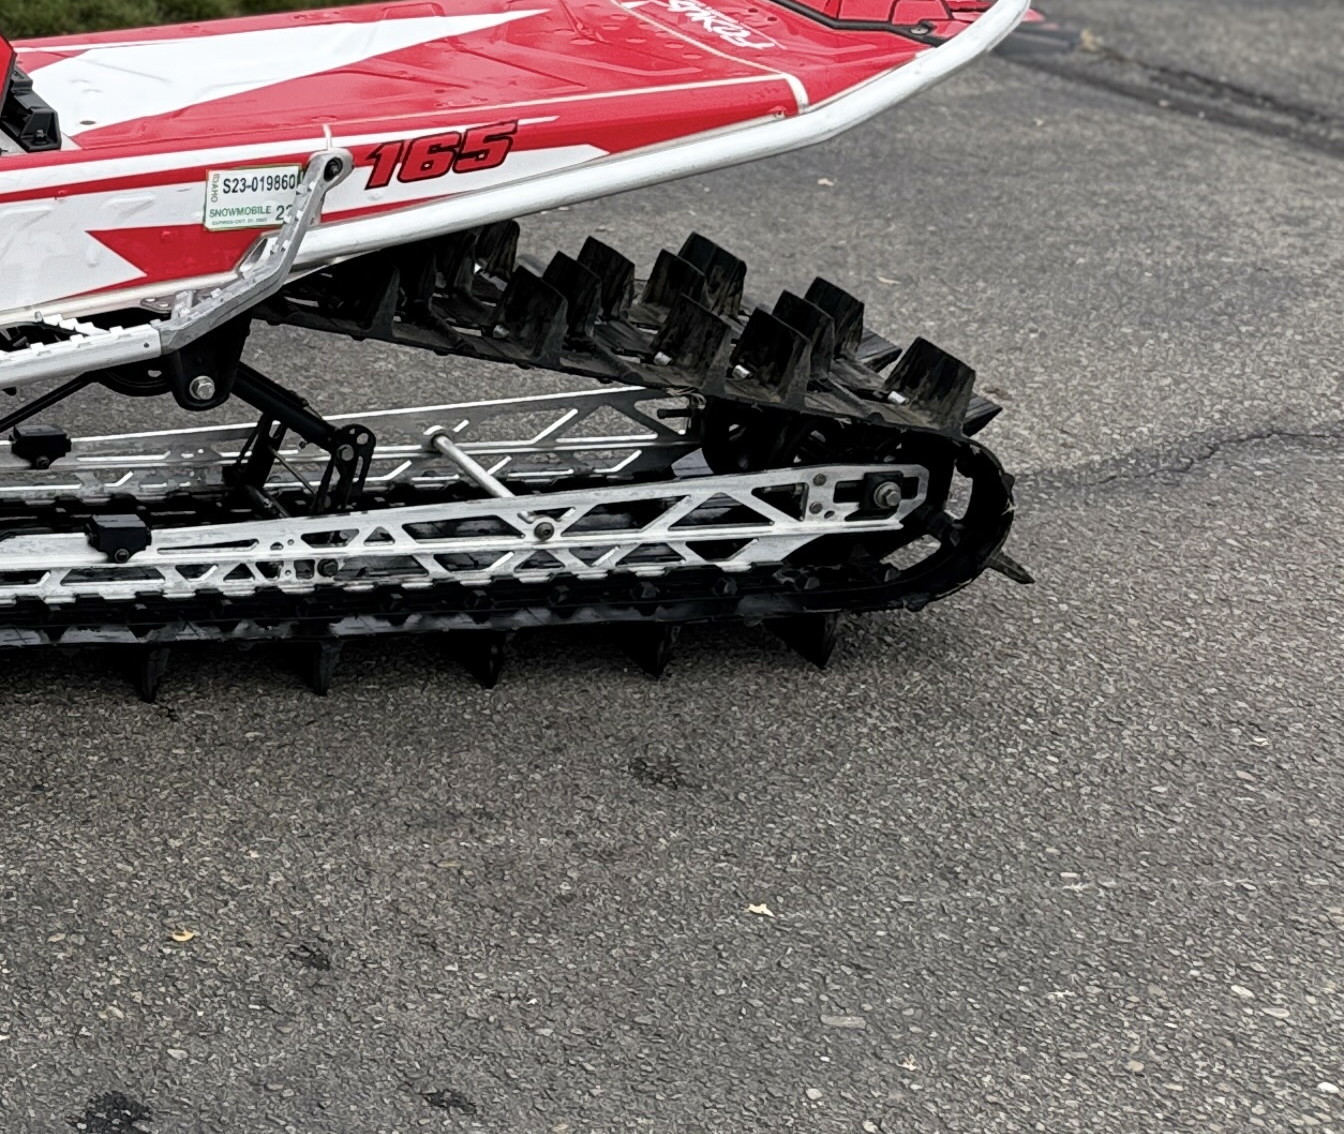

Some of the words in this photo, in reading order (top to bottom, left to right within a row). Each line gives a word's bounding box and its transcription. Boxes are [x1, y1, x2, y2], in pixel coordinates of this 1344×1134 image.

[364, 119, 519, 191] 165
[211, 174, 220, 203] IDAHO
[223, 174, 297, 194] S23-019860
[210, 206, 272, 218] SNOWMOBILE
